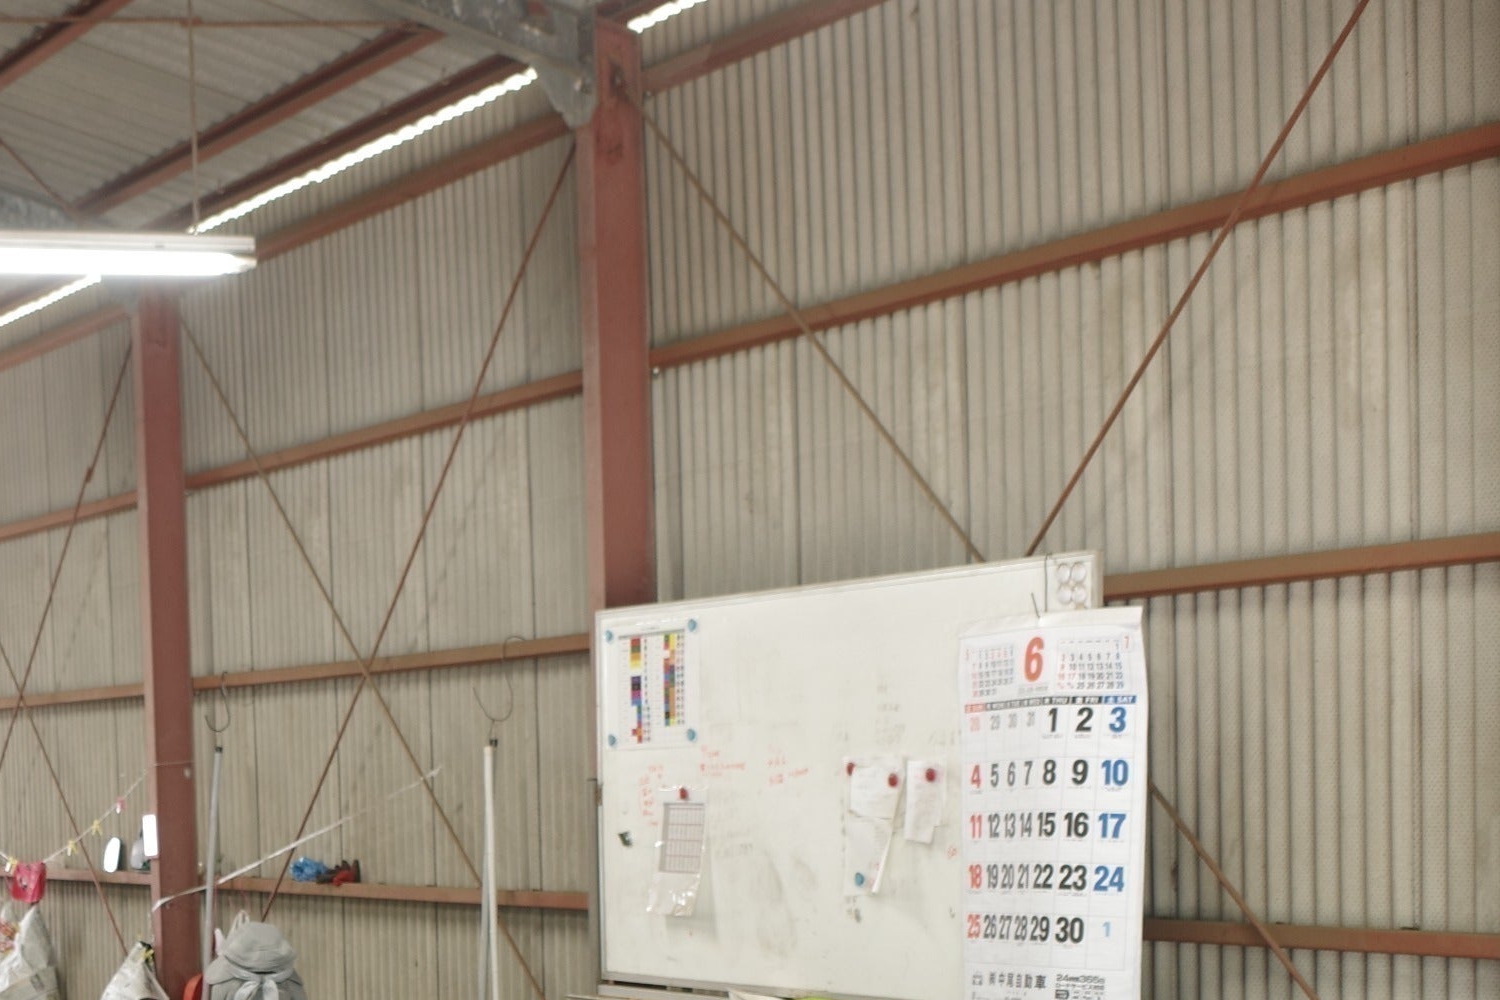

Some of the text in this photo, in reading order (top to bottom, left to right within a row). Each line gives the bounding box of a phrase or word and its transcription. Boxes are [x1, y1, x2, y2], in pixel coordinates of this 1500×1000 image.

[1024, 636, 1045, 682] 6
[1048, 707, 1058, 732] 1
[1075, 707, 1094, 732] 2
[1109, 707, 1127, 733] 3
[971, 759, 1129, 788] 4 5 6 7 8 9 10
[970, 812, 1127, 839] 11 12 13 14 15 16 17
[968, 864, 1124, 892] 18 19 20 21 22 23 24
[967, 914, 1111, 943] 25 26 27 28 29 30 1
